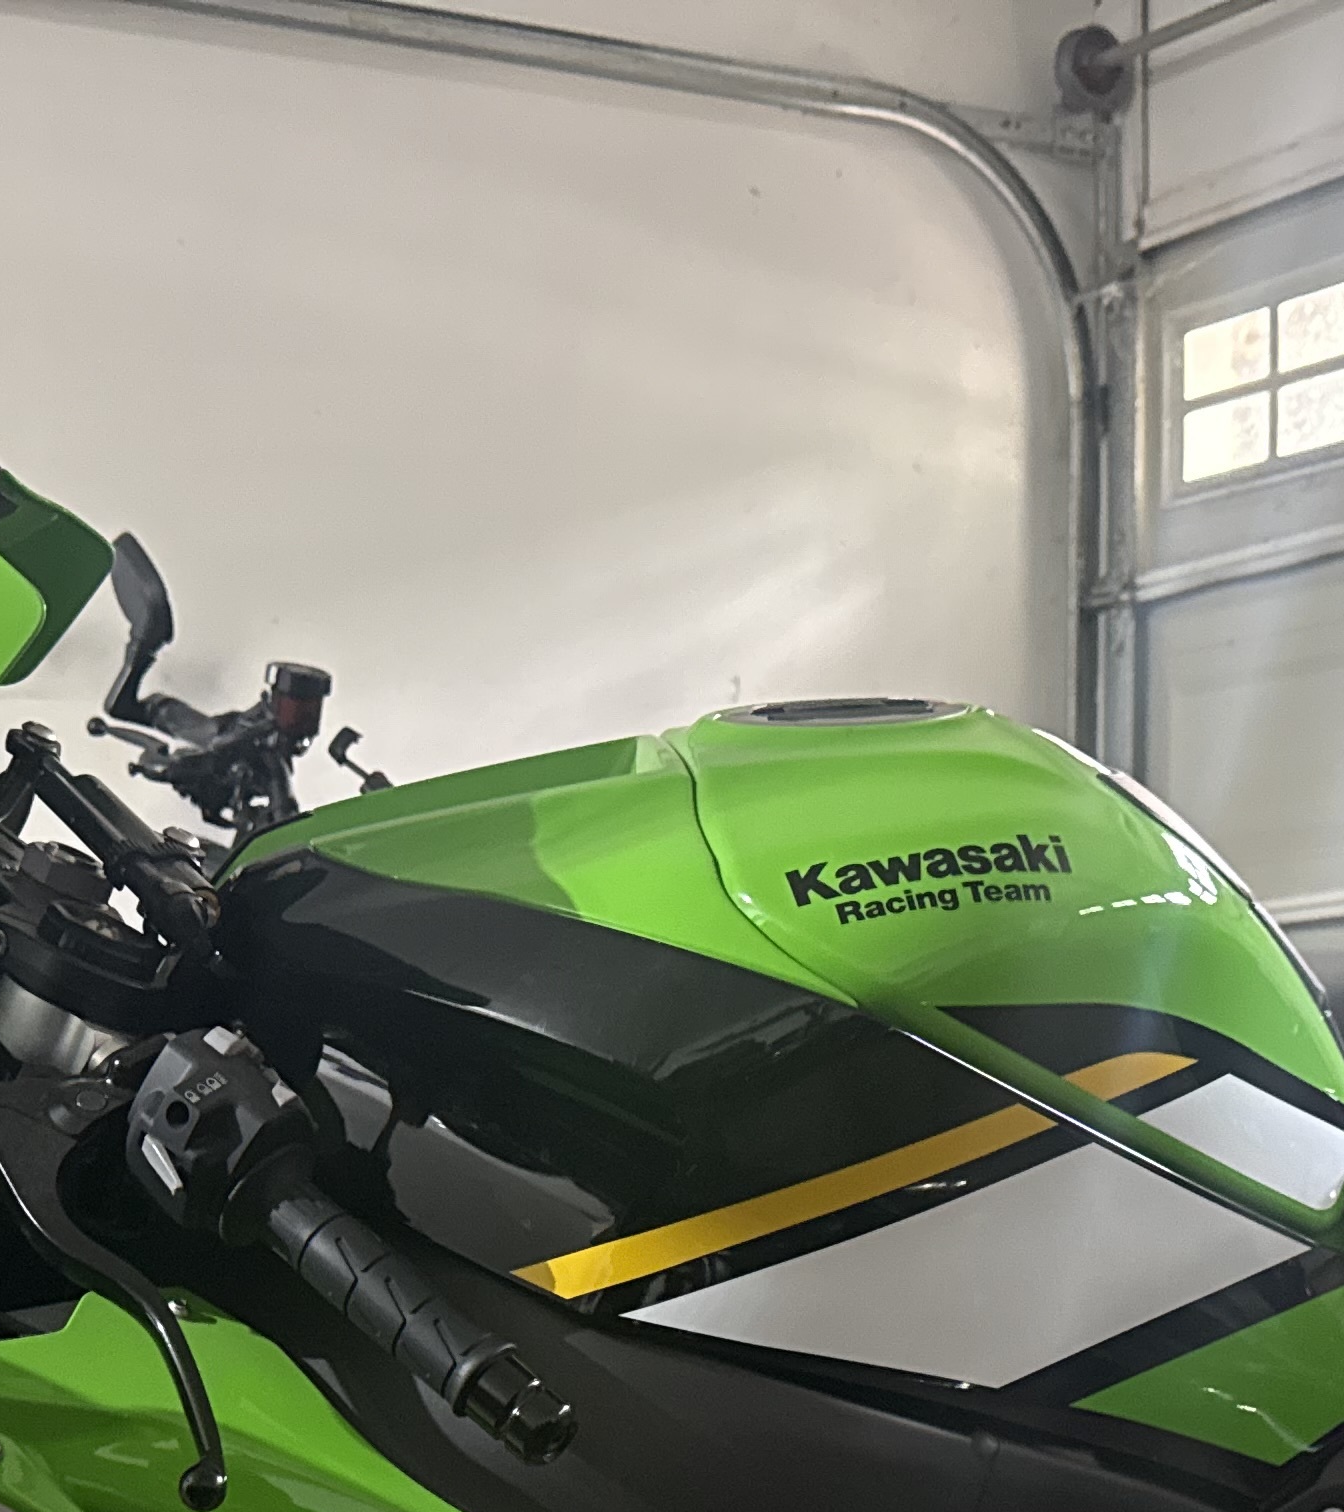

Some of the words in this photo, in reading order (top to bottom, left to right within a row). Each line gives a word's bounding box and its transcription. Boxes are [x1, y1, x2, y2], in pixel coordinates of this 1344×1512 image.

[785, 834, 1072, 907] Kawasaki
[835, 886, 959, 925] Racing
[962, 880, 1051, 903] Team
